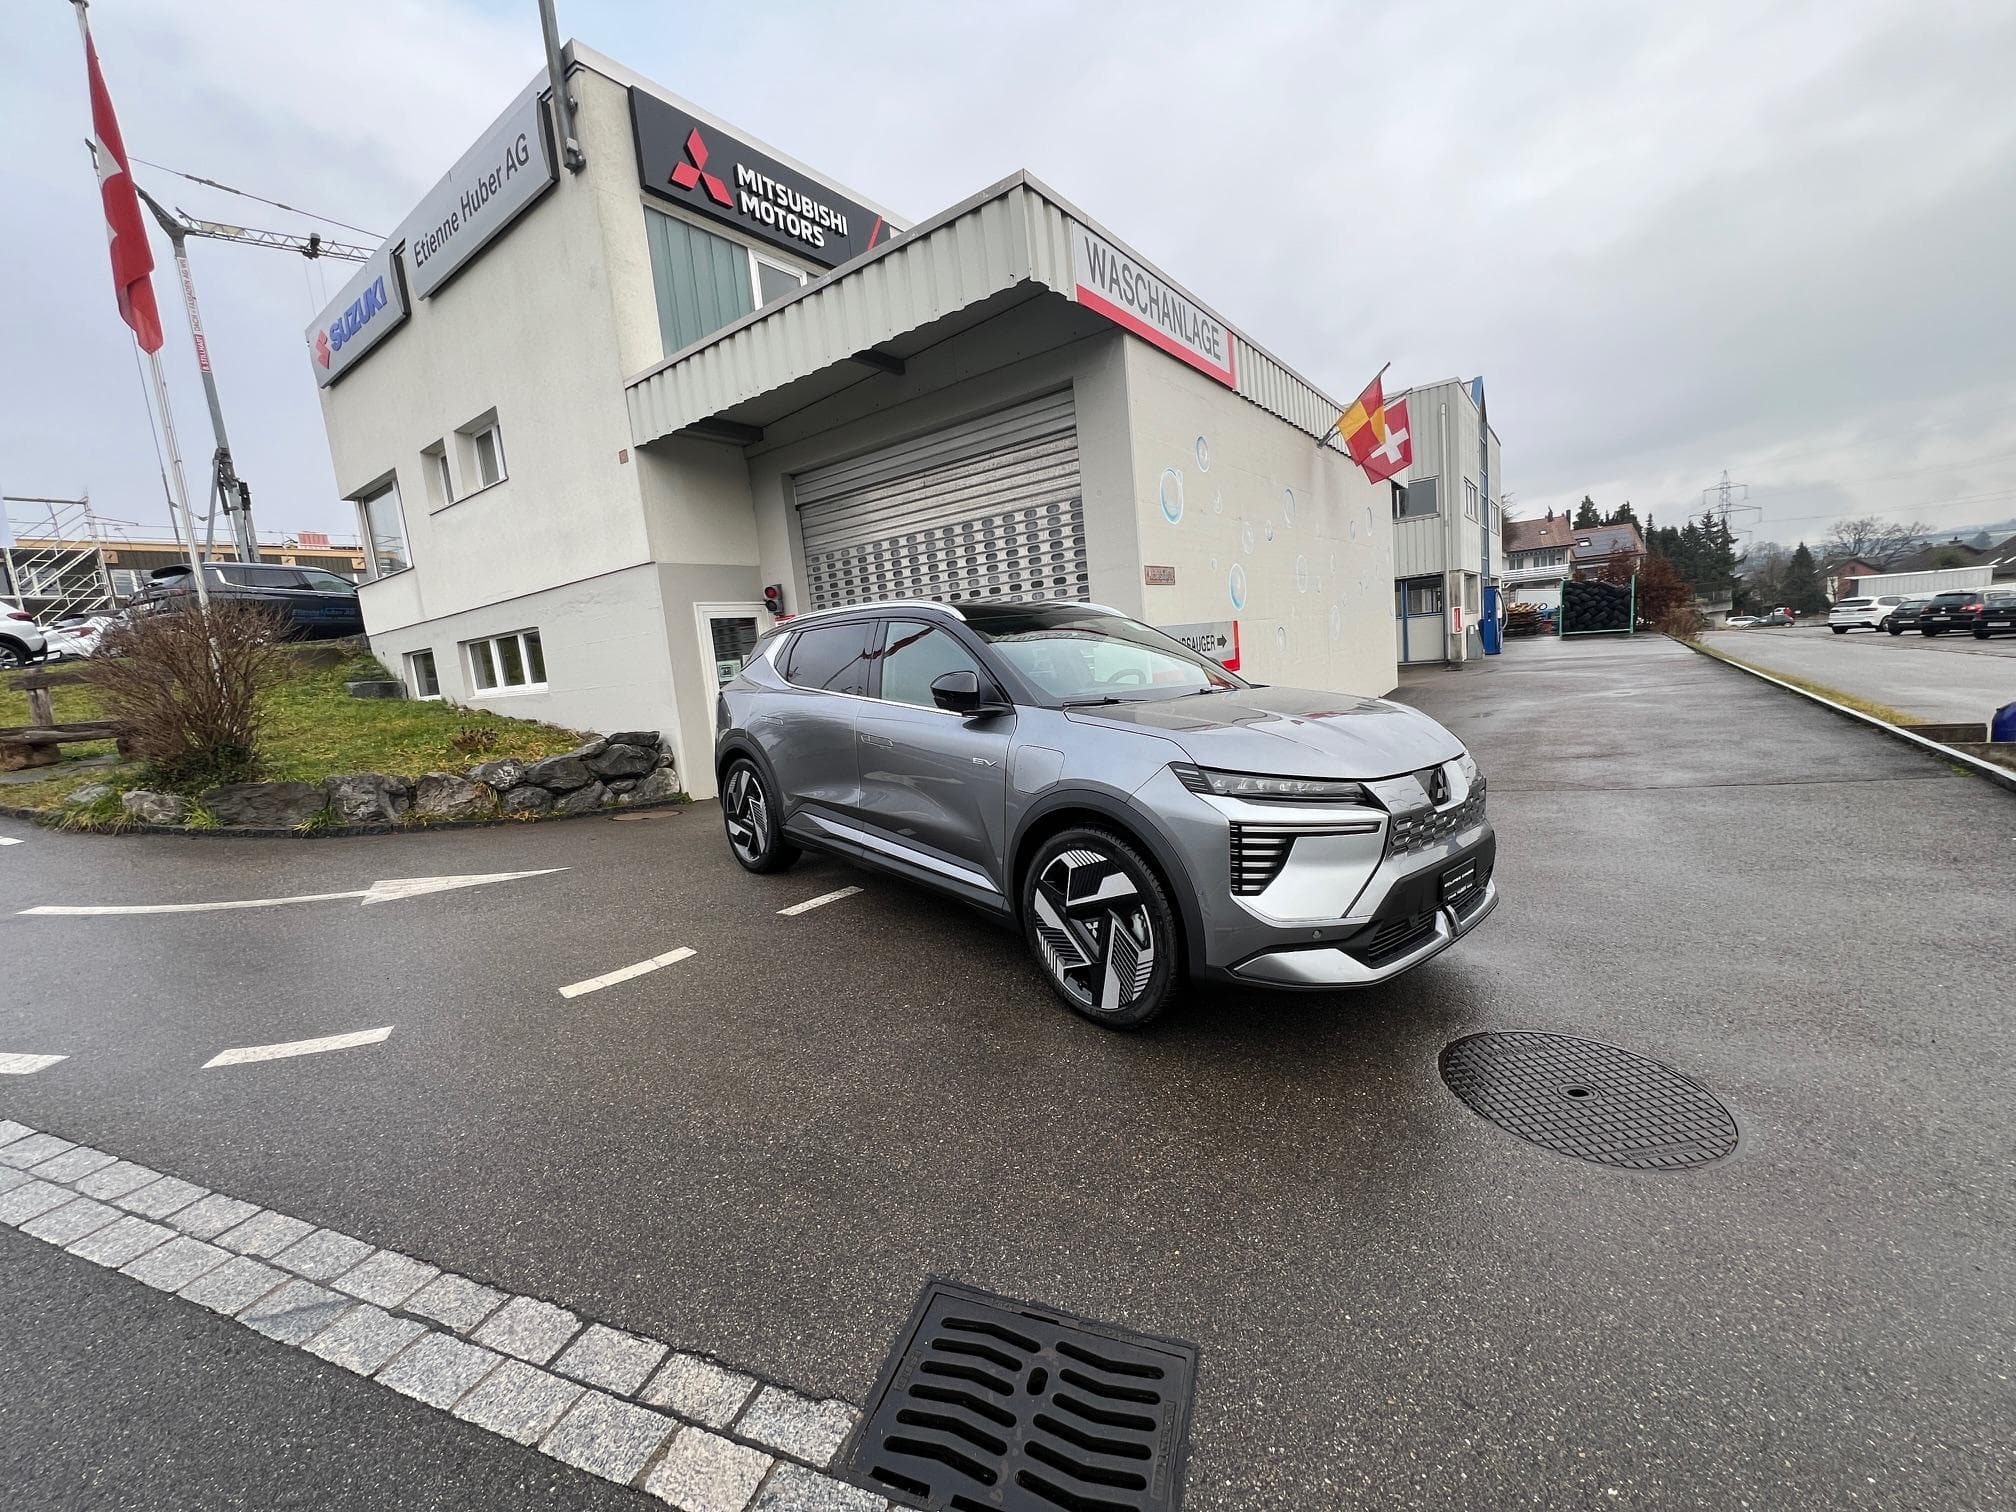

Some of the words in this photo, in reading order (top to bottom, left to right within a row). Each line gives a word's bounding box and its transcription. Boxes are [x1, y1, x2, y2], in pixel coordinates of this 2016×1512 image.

[413, 211, 460, 268] Etienne
[460, 164, 503, 222] Huber
[506, 133, 530, 180] AG
[736, 162, 848, 236] MITSUBISHI
[739, 190, 825, 247] MOTORS
[329, 275, 388, 351] SUZUKI
[1084, 236, 1221, 361] WASCHANLAGE
[972, 757, 998, 767] EV
